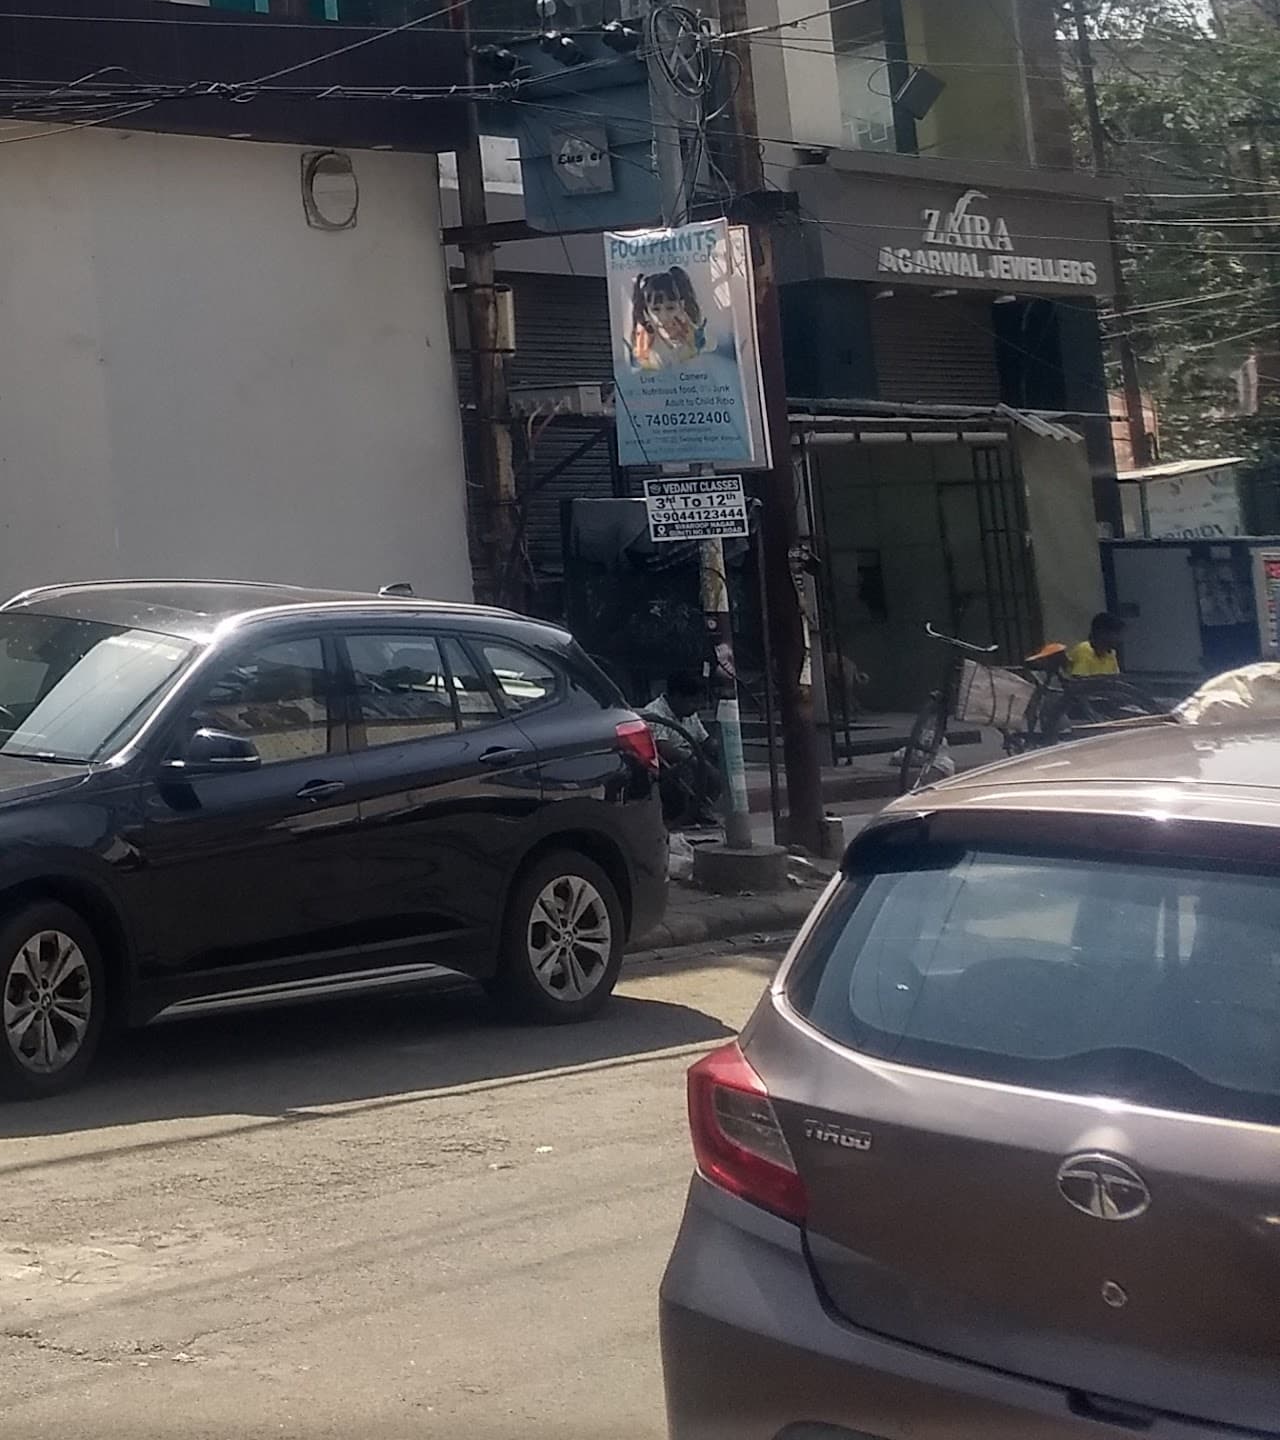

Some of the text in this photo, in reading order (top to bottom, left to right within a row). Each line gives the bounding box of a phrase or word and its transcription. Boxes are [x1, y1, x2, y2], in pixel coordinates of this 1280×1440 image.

[923, 194, 1014, 251] ZAIRA
[610, 228, 717, 259] FOOTPRINTS
[878, 246, 1097, 285] AGARWAL JEWELLERS
[645, 411, 731, 427] 7406222400
[662, 480, 739, 494] VEDANT CLASSES
[680, 496, 702, 508] To
[706, 493, 736, 507] 12th
[663, 508, 744, 522] 9044123444
